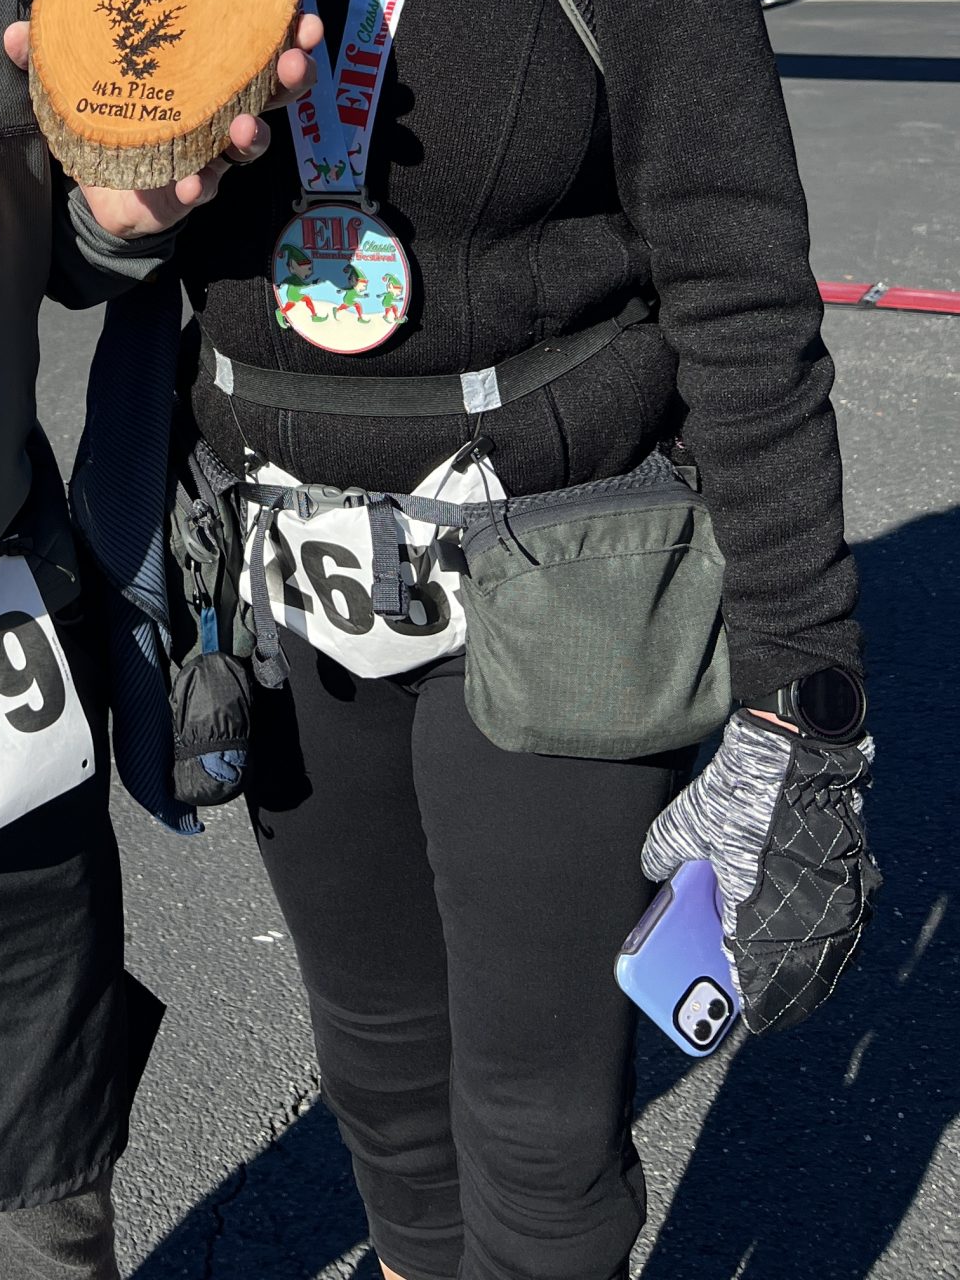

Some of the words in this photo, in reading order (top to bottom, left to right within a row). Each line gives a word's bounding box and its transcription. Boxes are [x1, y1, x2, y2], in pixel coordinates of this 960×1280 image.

[92, 80, 122, 98] 4th
[127, 81, 175, 101] Place
[336, 42, 383, 131] Elf
[76, 98, 136, 120] Overall
[138, 104, 182, 122] Male
[301, 216, 362, 251] Elf
